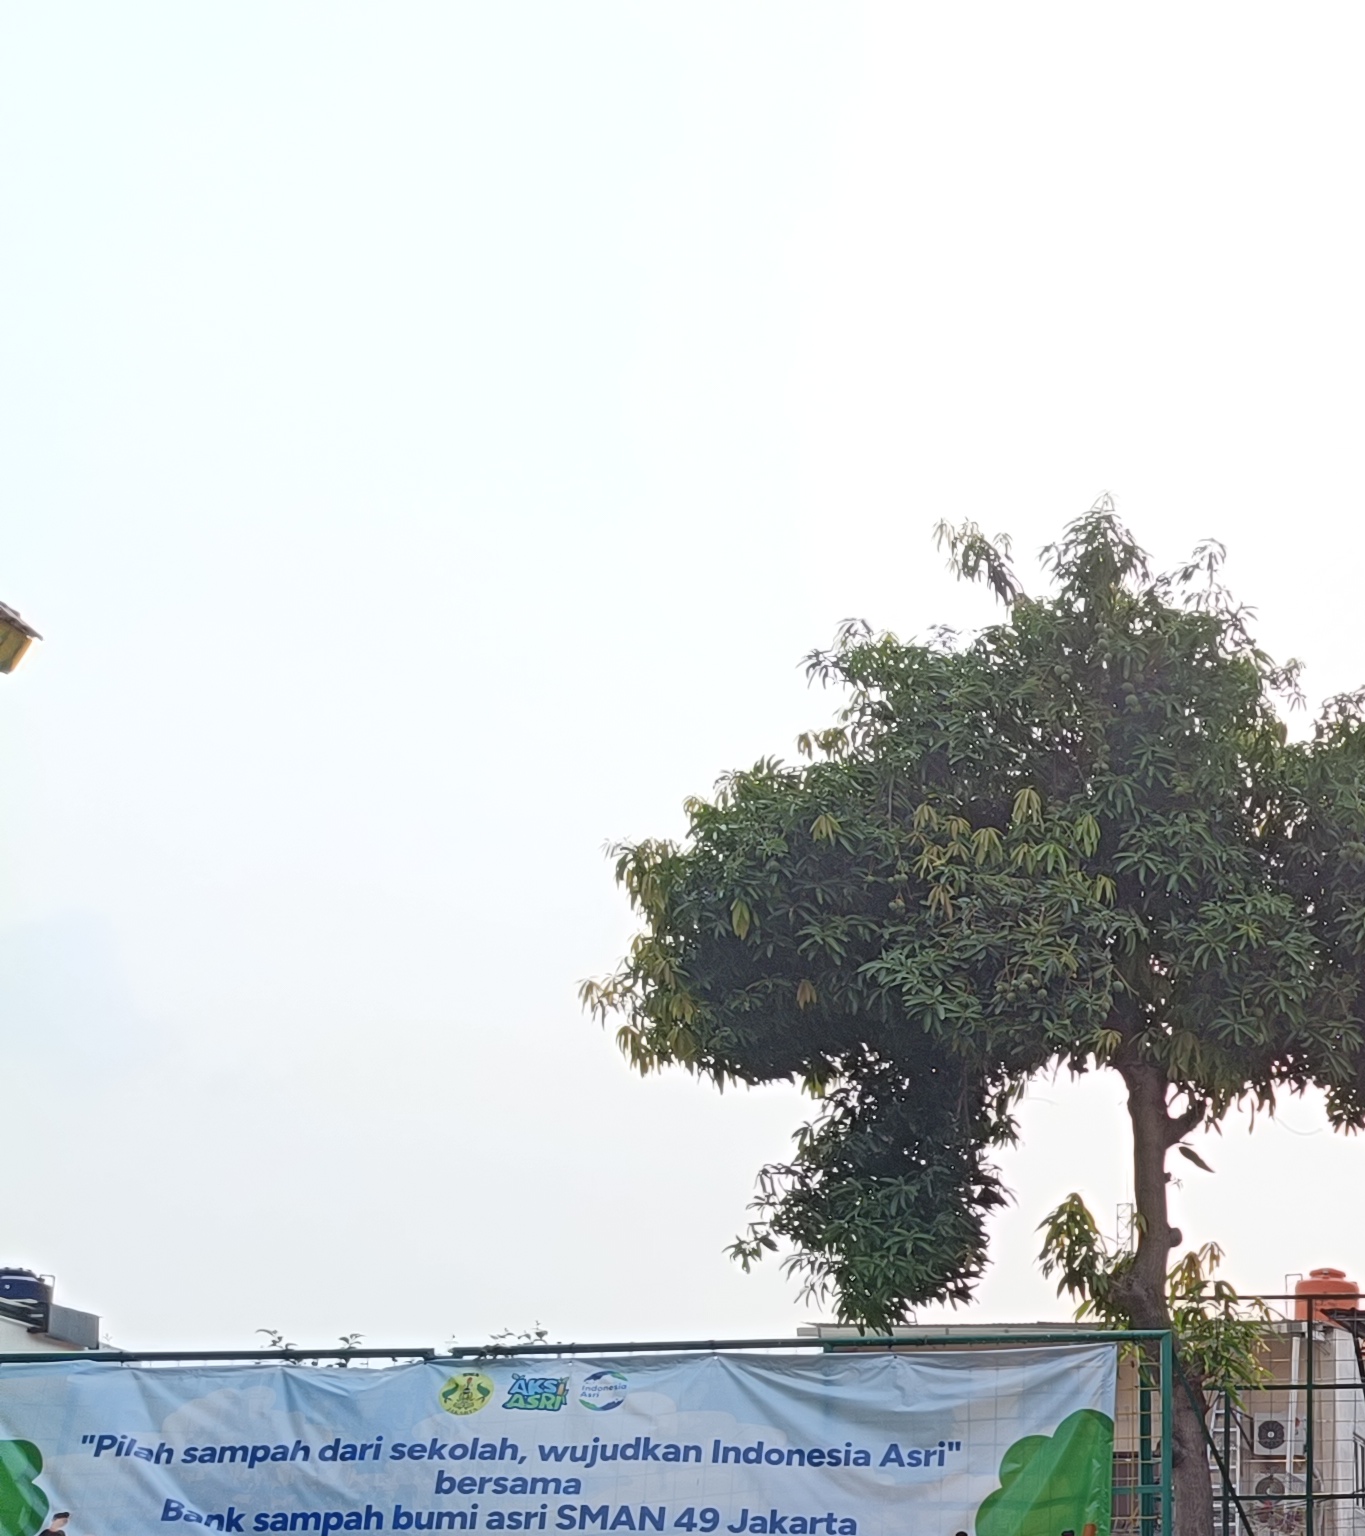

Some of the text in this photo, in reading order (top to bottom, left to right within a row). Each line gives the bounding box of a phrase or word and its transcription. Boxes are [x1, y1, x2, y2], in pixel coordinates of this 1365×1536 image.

[580, 1383, 628, 1392] Indonesia
[580, 1391, 600, 1399] Asri
[505, 1393, 563, 1411] ASRI
[81, 1434, 962, 1469] "Pilah sampah dari sekolah, wujudkan Indonesia Asri"
[434, 1469, 582, 1495] bersama
[160, 1498, 858, 1536] Bank sampah bumi asri SMAN 49 Jakarta
